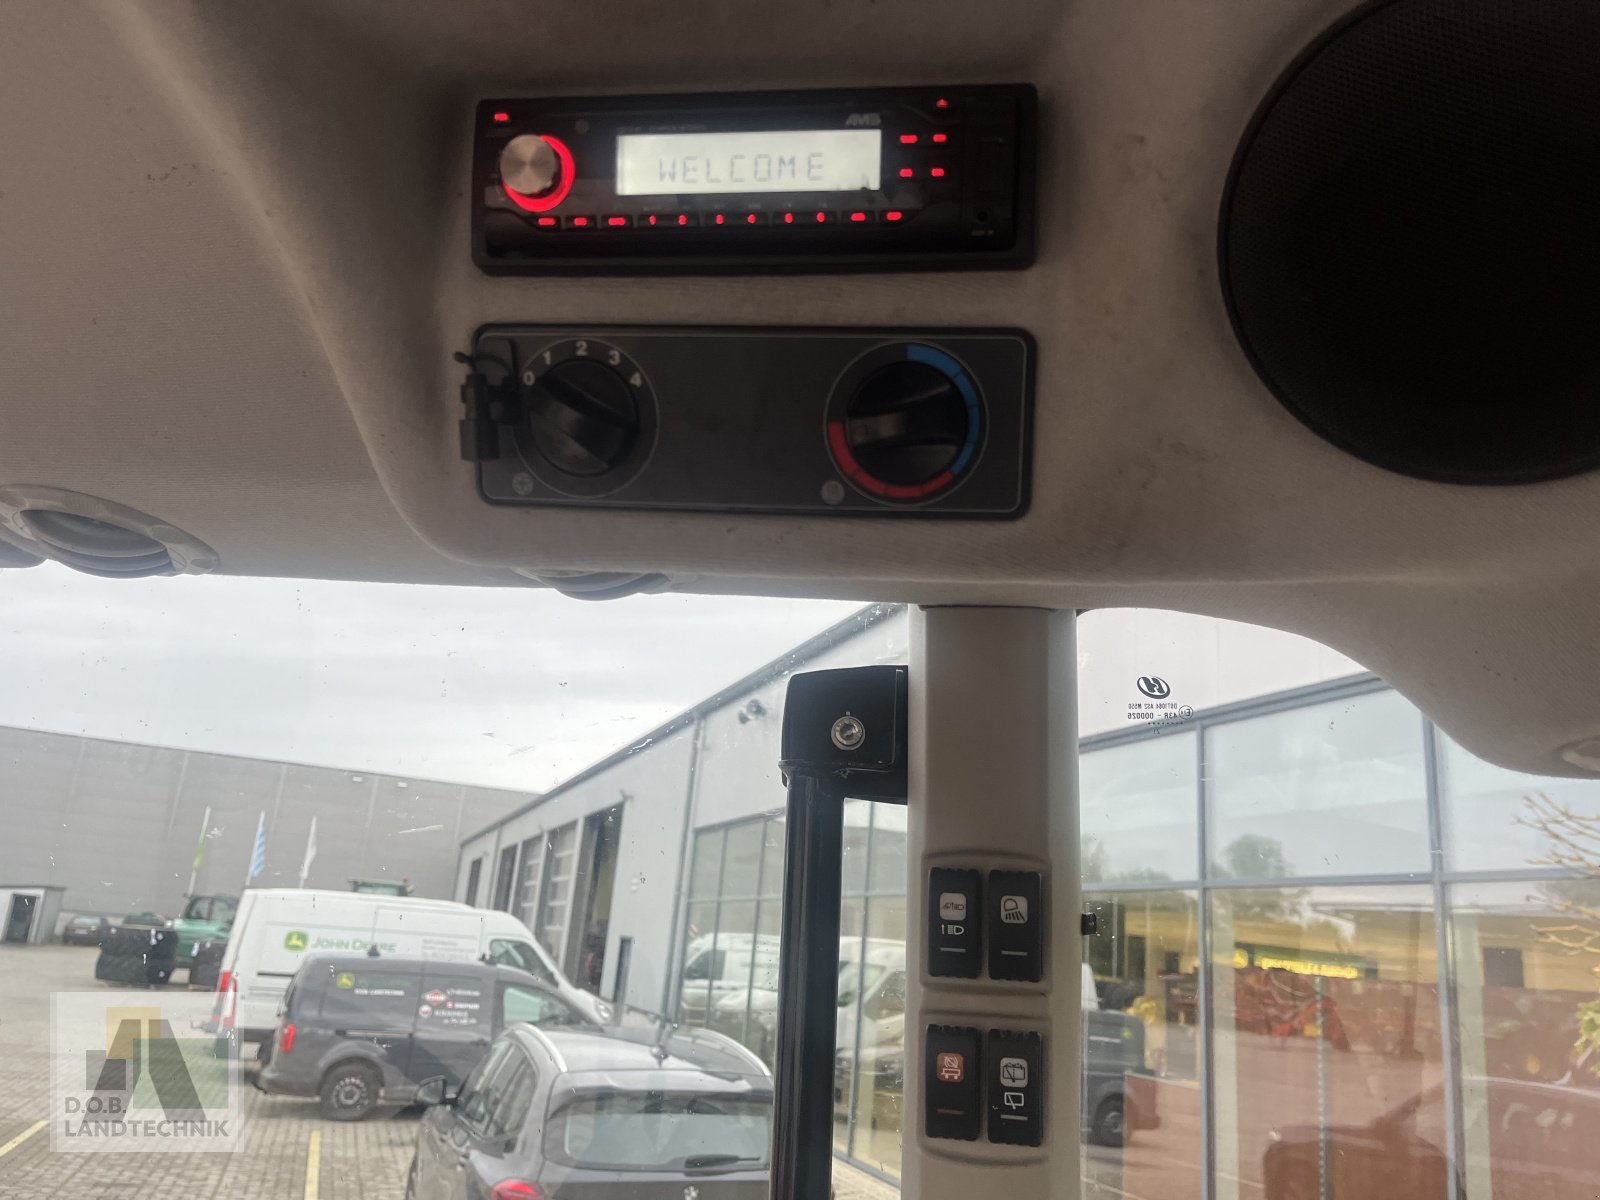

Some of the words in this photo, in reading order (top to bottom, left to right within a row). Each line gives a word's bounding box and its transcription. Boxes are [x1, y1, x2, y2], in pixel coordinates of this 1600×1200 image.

[658, 152, 824, 184] WELCOME
[523, 371, 535, 386] 0
[542, 350, 552, 366] 1
[576, 340, 588, 357] 2
[608, 350, 620, 366] 3
[629, 371, 641, 387] 4
[351, 938, 396, 952] DERE
